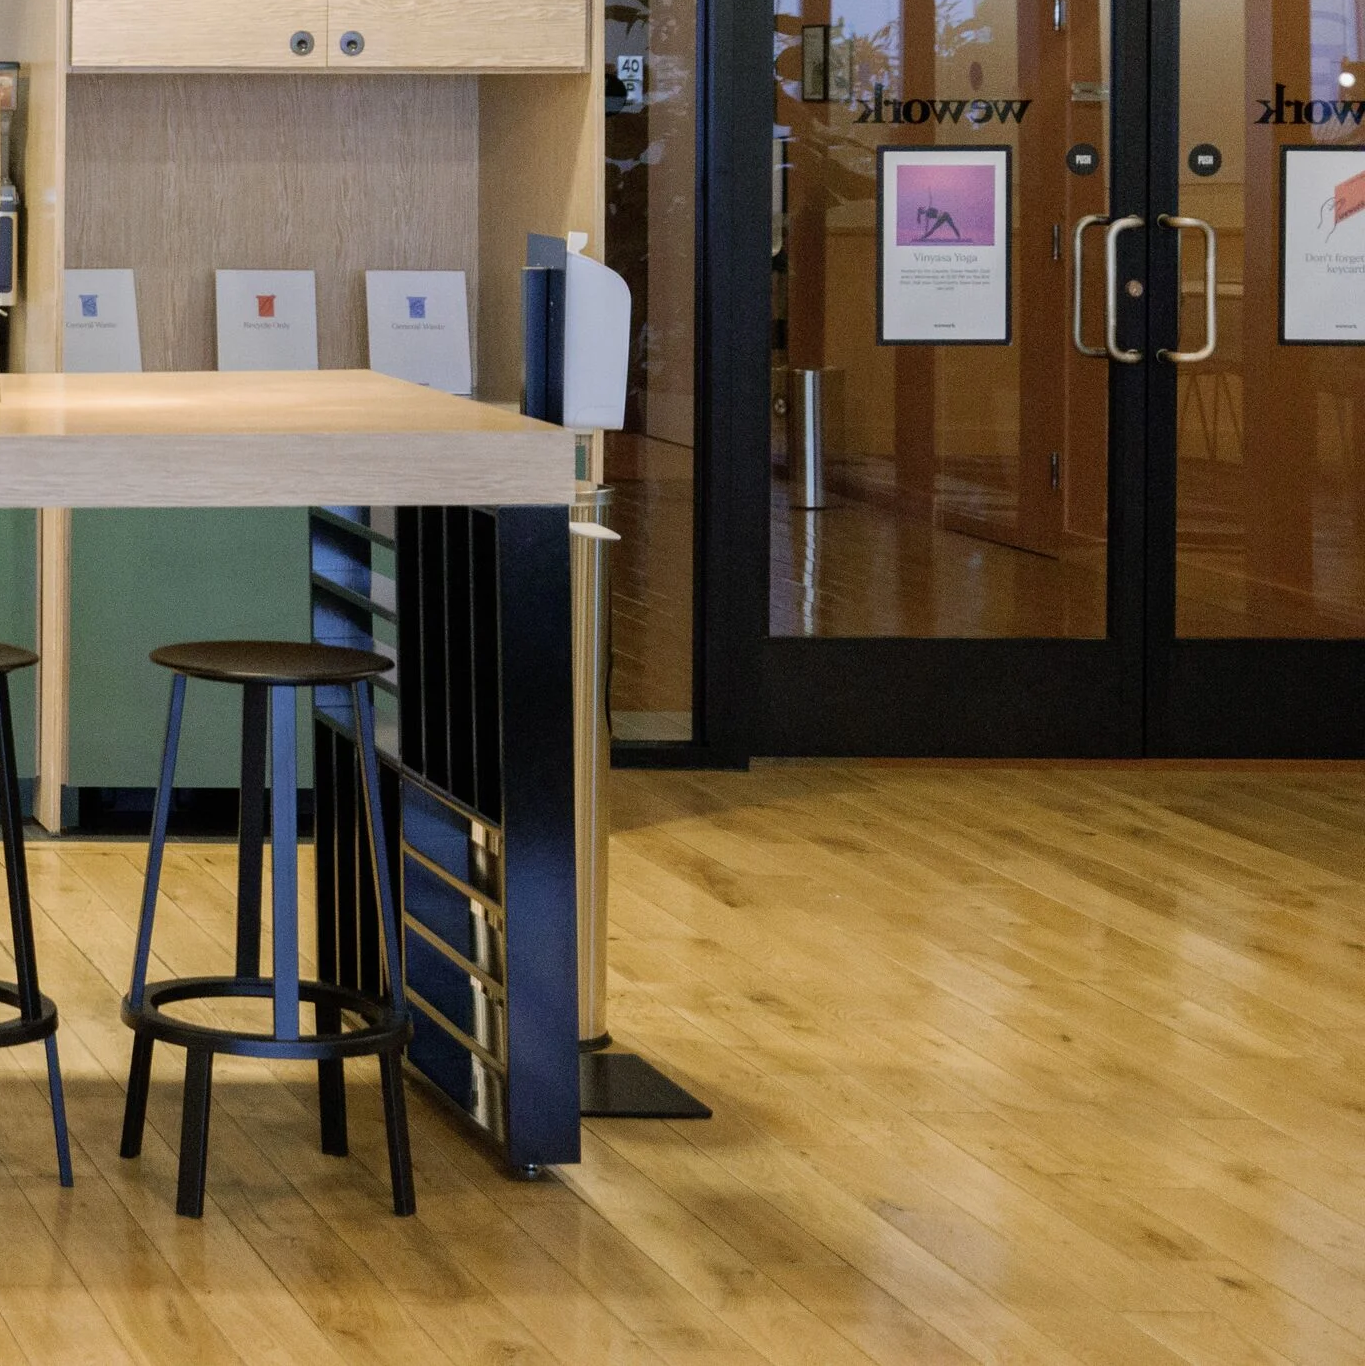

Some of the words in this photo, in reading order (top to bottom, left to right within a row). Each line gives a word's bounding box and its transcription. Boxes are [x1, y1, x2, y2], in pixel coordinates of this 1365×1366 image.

[621, 59, 640, 73] 40
[1075, 154, 1092, 165] PUSH
[1197, 155, 1214, 165] PUSH
[913, 252, 952, 264] Vinyasa
[954, 252, 978, 264] Yoga
[1305, 252, 1332, 263] Don't
[1335, 252, 1365, 265] forget
